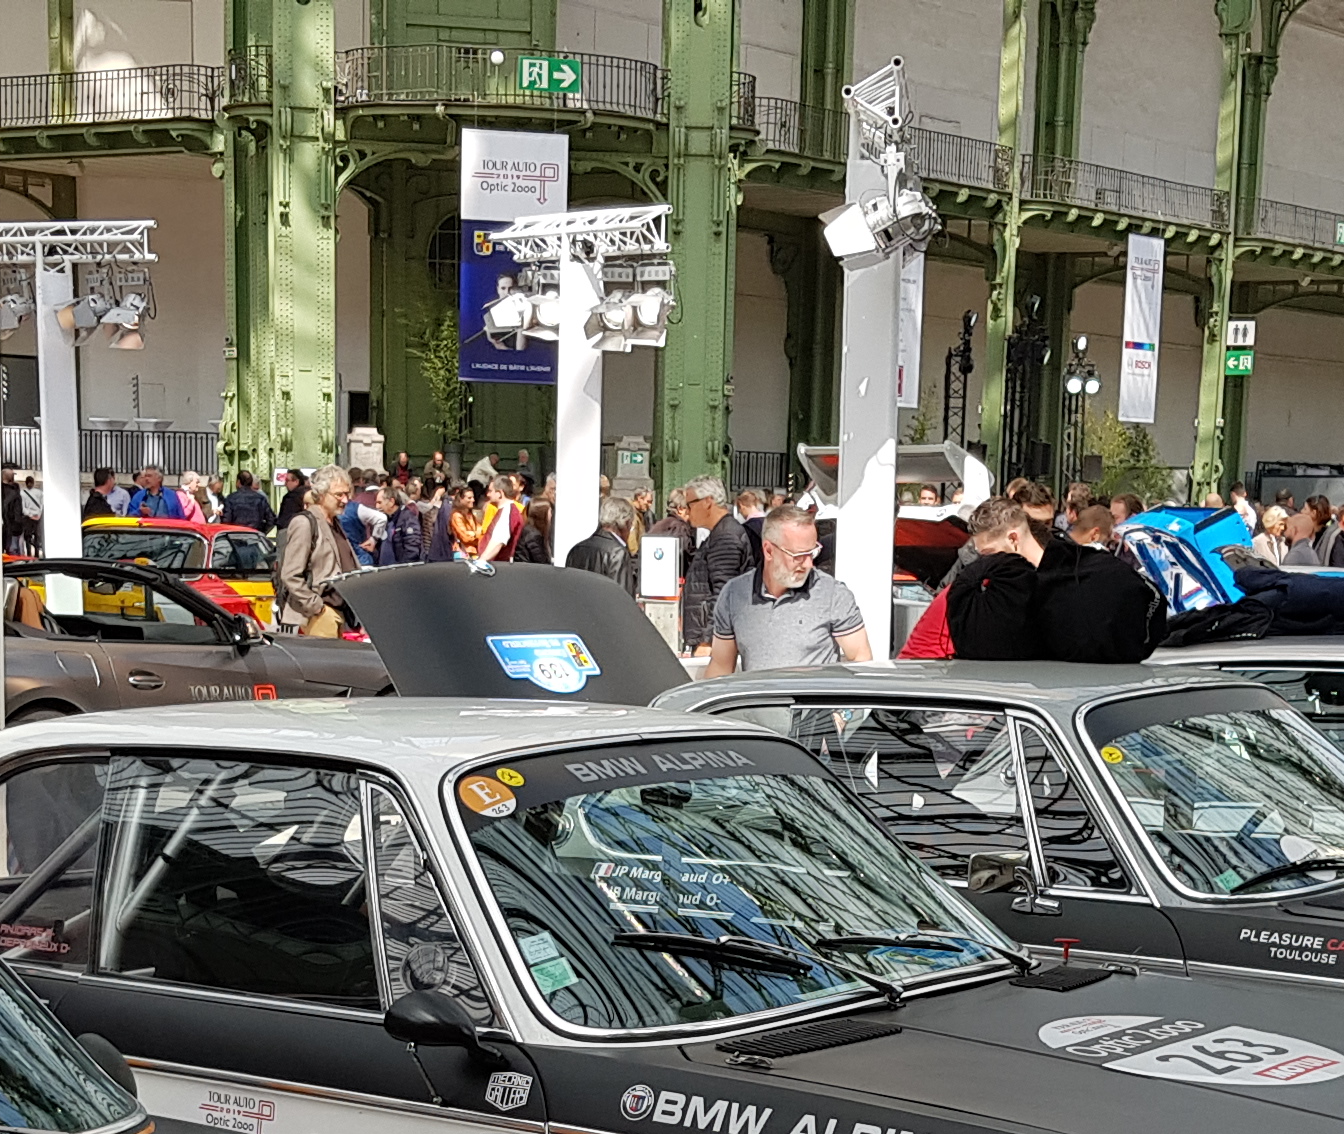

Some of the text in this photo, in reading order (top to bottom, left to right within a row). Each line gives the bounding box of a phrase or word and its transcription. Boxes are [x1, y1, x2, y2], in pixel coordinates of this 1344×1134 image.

[482, 159, 537, 173] TOUR AUTO
[480, 181, 537, 194] Optic 2000
[189, 684, 252, 701] TOUR AUTO
[564, 750, 756, 783] BMW ALPINA
[467, 780, 502, 805] E
[491, 802, 510, 814] 263
[1239, 927, 1325, 949] PLEASURE
[1269, 947, 1338, 965] TOULOUSE
[1064, 1036, 1143, 1058] Optic
[1155, 1037, 1290, 1076] 263
[1269, 1056, 1334, 1080] MOTUL
[207, 1089, 256, 1110] TOUR AUTO
[219, 1107, 242, 1116] 2019
[205, 1113, 231, 1131] Optic
